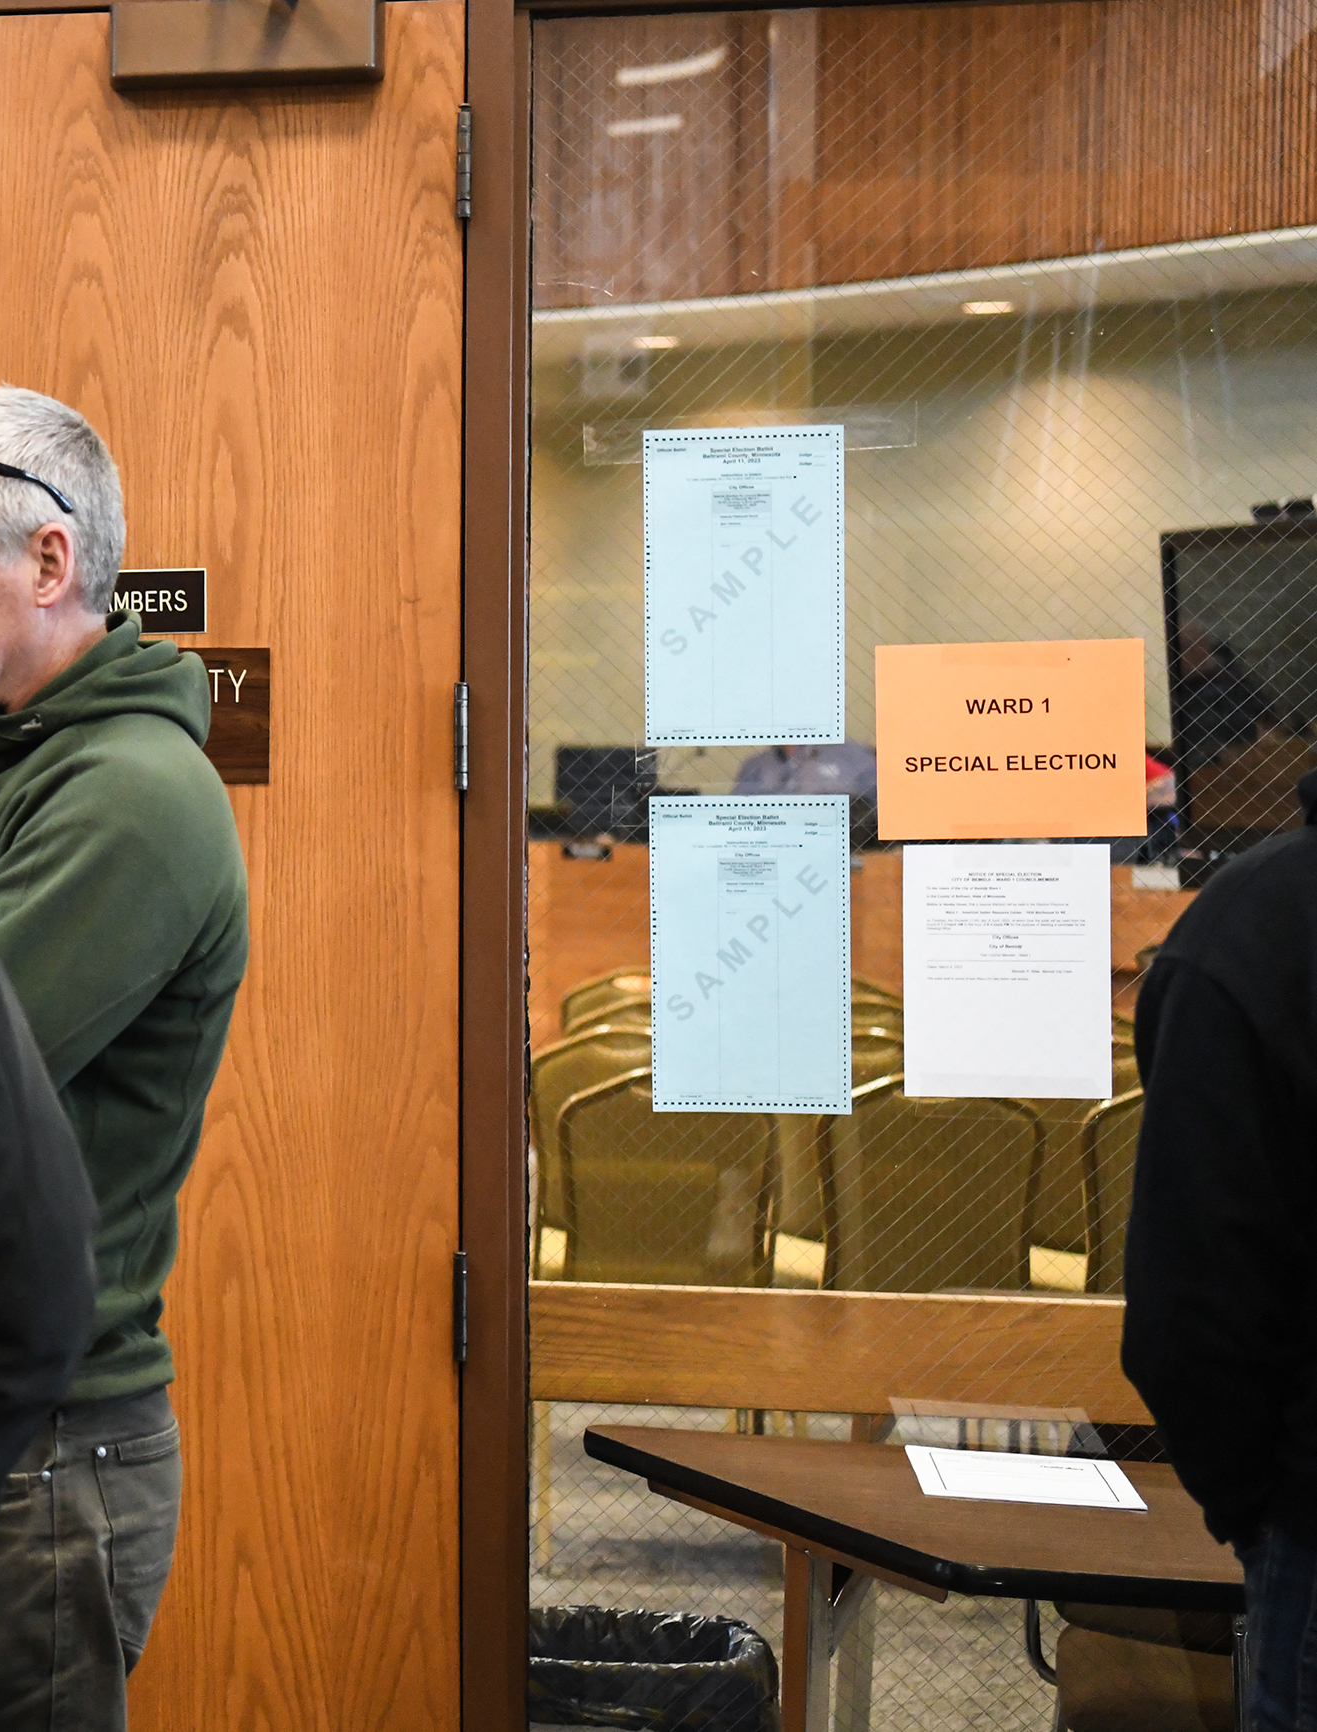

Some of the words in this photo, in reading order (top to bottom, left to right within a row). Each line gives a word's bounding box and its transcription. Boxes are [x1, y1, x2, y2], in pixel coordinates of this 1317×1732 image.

[659, 495, 823, 656] SAMPLE
[108, 590, 188, 613] MBERS
[208, 669, 247, 703] TY
[965, 698, 1034, 715] WARD
[1040, 697, 1050, 713] 1
[905, 755, 999, 773] SPECIAL
[1006, 753, 1117, 771] ELECTION
[666, 864, 829, 1022] SAMPLE
